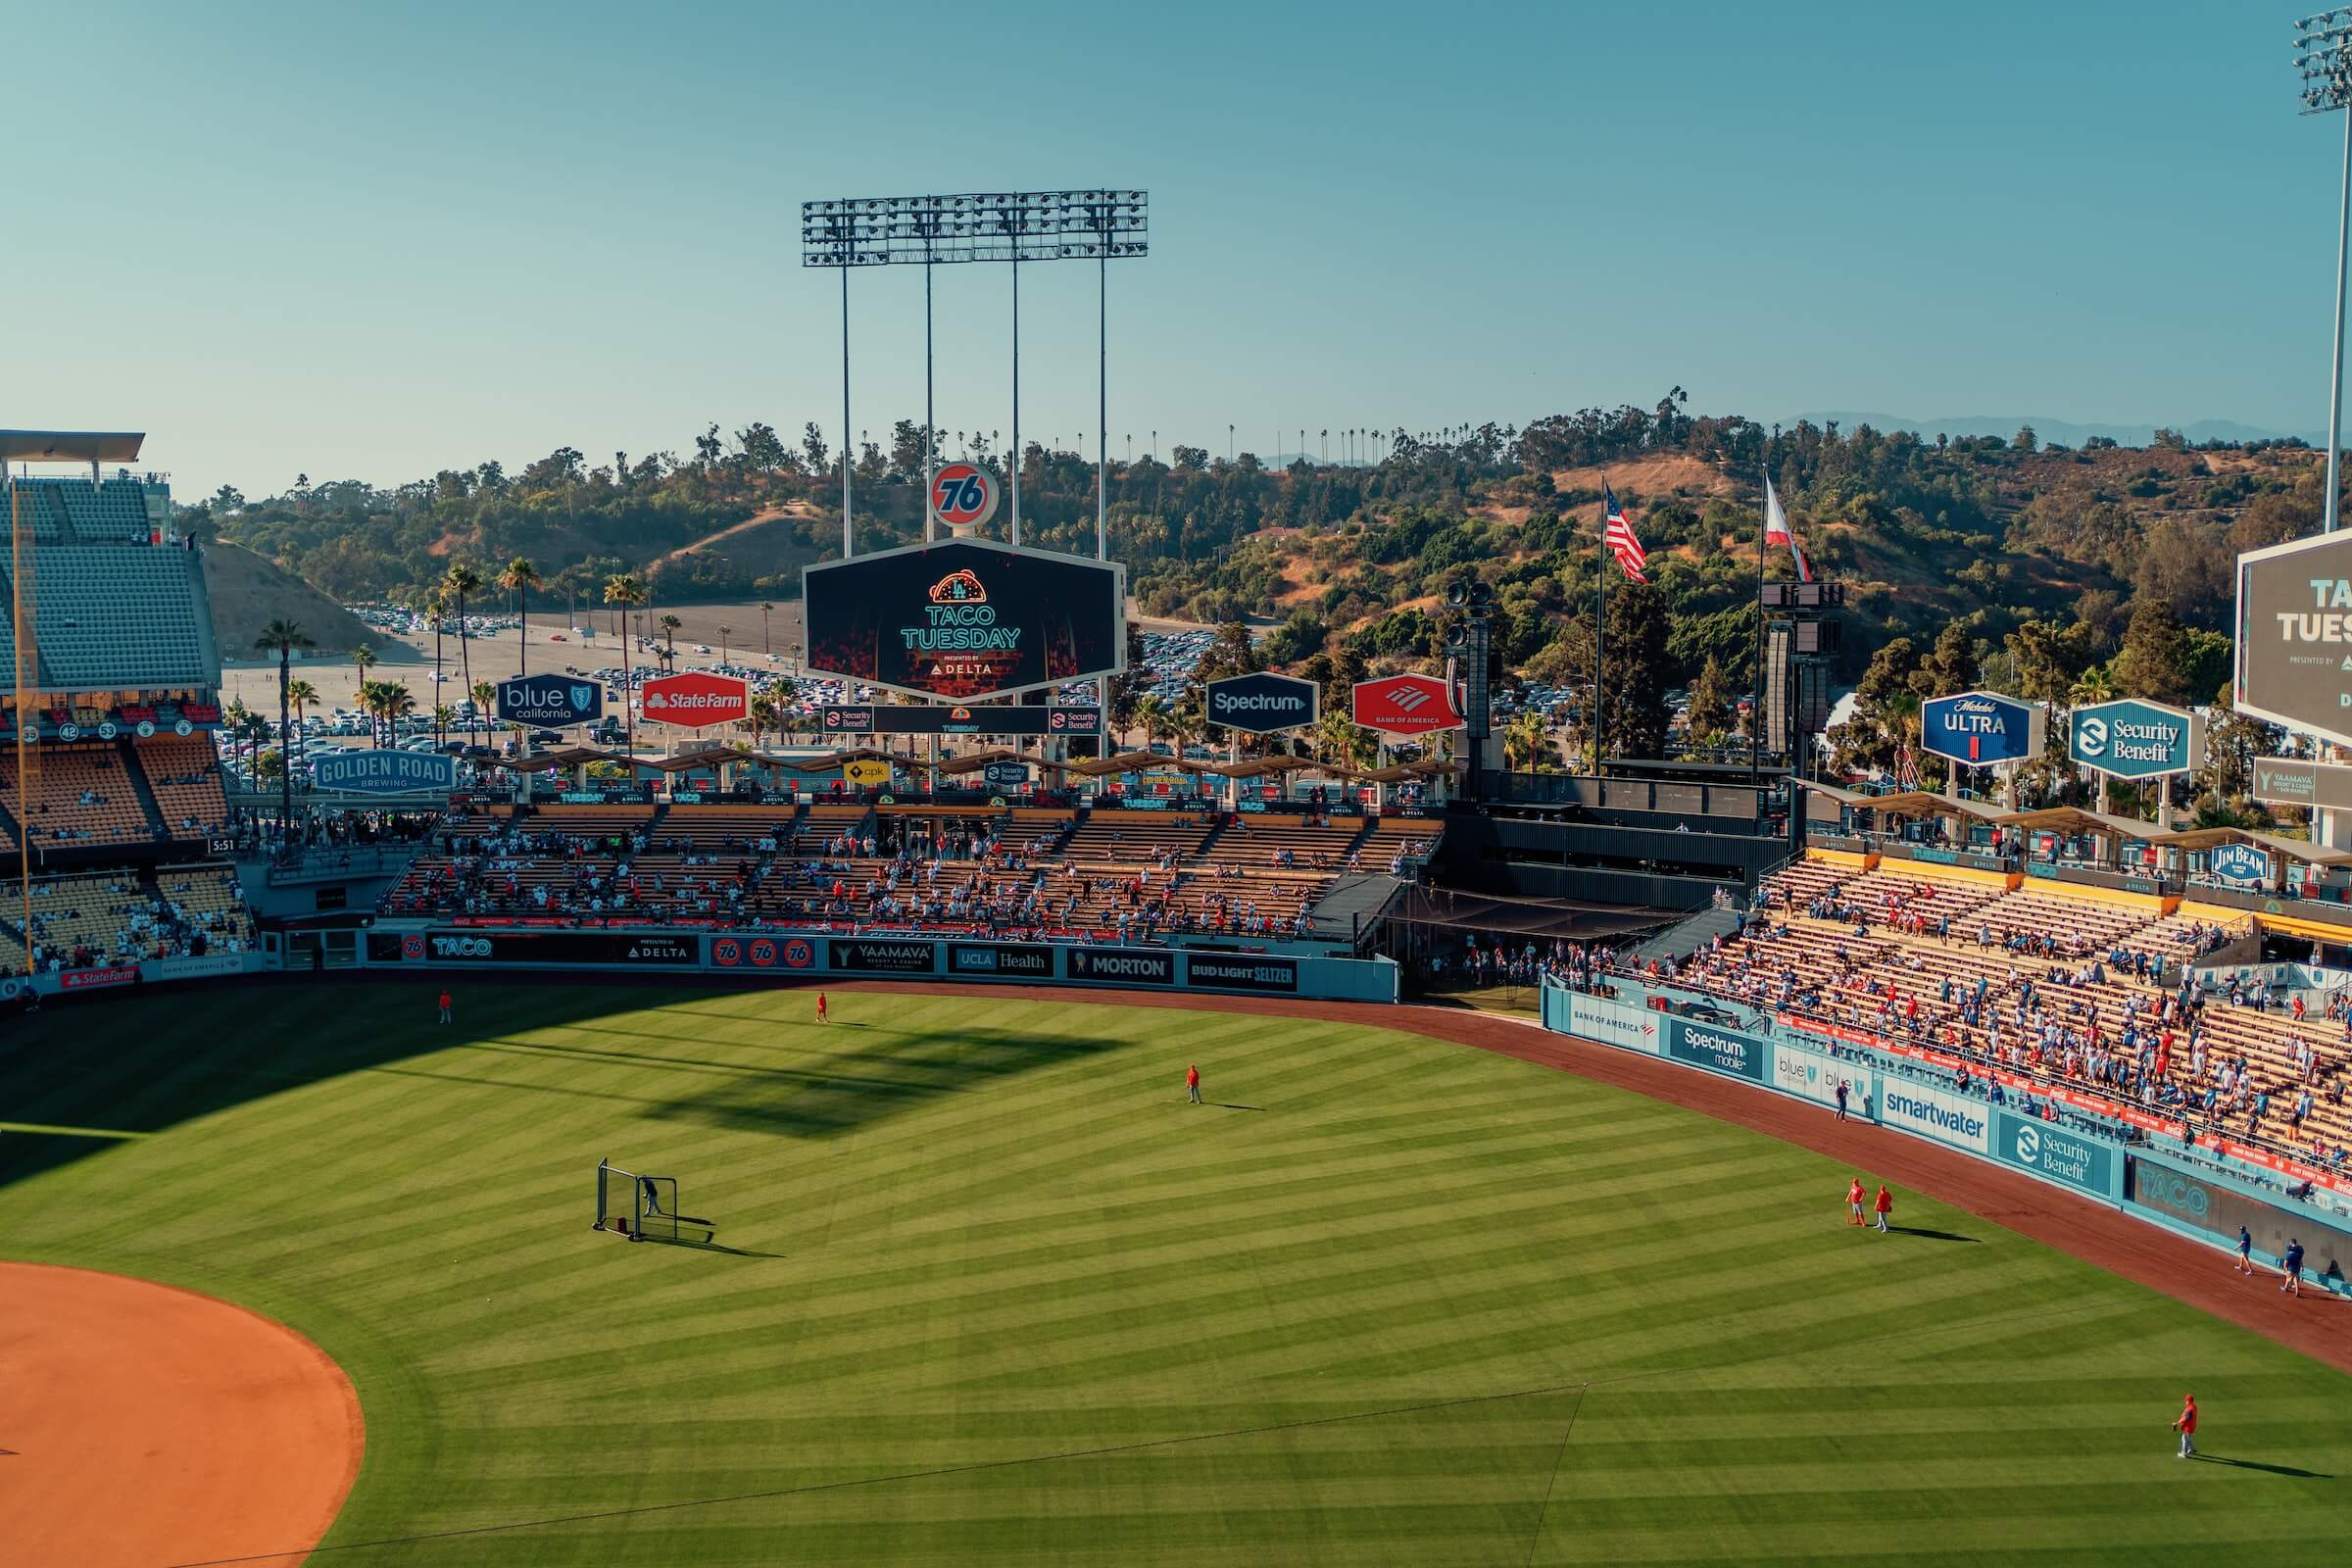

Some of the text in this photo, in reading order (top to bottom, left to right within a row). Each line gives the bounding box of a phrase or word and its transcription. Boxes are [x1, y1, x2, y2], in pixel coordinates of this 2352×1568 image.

[938, 474, 984, 513] 76
[953, 579, 966, 599] LA
[925, 606, 996, 626] TACO
[901, 628, 1021, 650] TUESDAY
[946, 664, 992, 674] DELTA
[2289, 656, 2325, 664] PRESENTED
[507, 684, 564, 708] blue
[1215, 692, 1299, 713] Spectrum
[516, 708, 571, 718] california
[1954, 699, 1996, 713] Michelob
[842, 710, 871, 721] Security
[843, 719, 870, 728] Benefit
[1067, 712, 1099, 723] Security
[1068, 720, 1096, 729] Benefit
[1944, 713, 2006, 734] ULTRA
[62, 727, 76, 737] 42
[101, 726, 115, 735] 53
[2114, 719, 2179, 746] Security
[2114, 741, 2169, 761] Benefit
[322, 757, 446, 783] GOLDEN ROAD
[864, 766, 884, 777] cpk
[1001, 766, 1025, 775] Security
[213, 839, 234, 851] 5:51
[2215, 846, 2264, 875] JIM BEAM
[407, 941, 421, 954] 76
[432, 938, 492, 956] TACO
[643, 948, 687, 957] DELTA
[717, 944, 807, 960] 76 76 76
[858, 944, 930, 959] YAAMAVA'
[961, 954, 1045, 969] UCLA Health
[1093, 956, 1164, 976] MORTON
[1192, 965, 1293, 984] BUD LIGHT SELTZER
[1574, 1010, 1595, 1022] BANK
[1606, 1018, 1639, 1033] AMERICA
[1685, 1027, 1743, 1057] Spectrum
[1715, 1053, 1742, 1070] mobile
[1780, 1055, 1804, 1077] blue
[1887, 1093, 1984, 1138] smartwater
[2043, 1133, 2091, 1166] Security
[2043, 1153, 2085, 1181] Benefit
[2136, 1165, 2209, 1216] TACO
